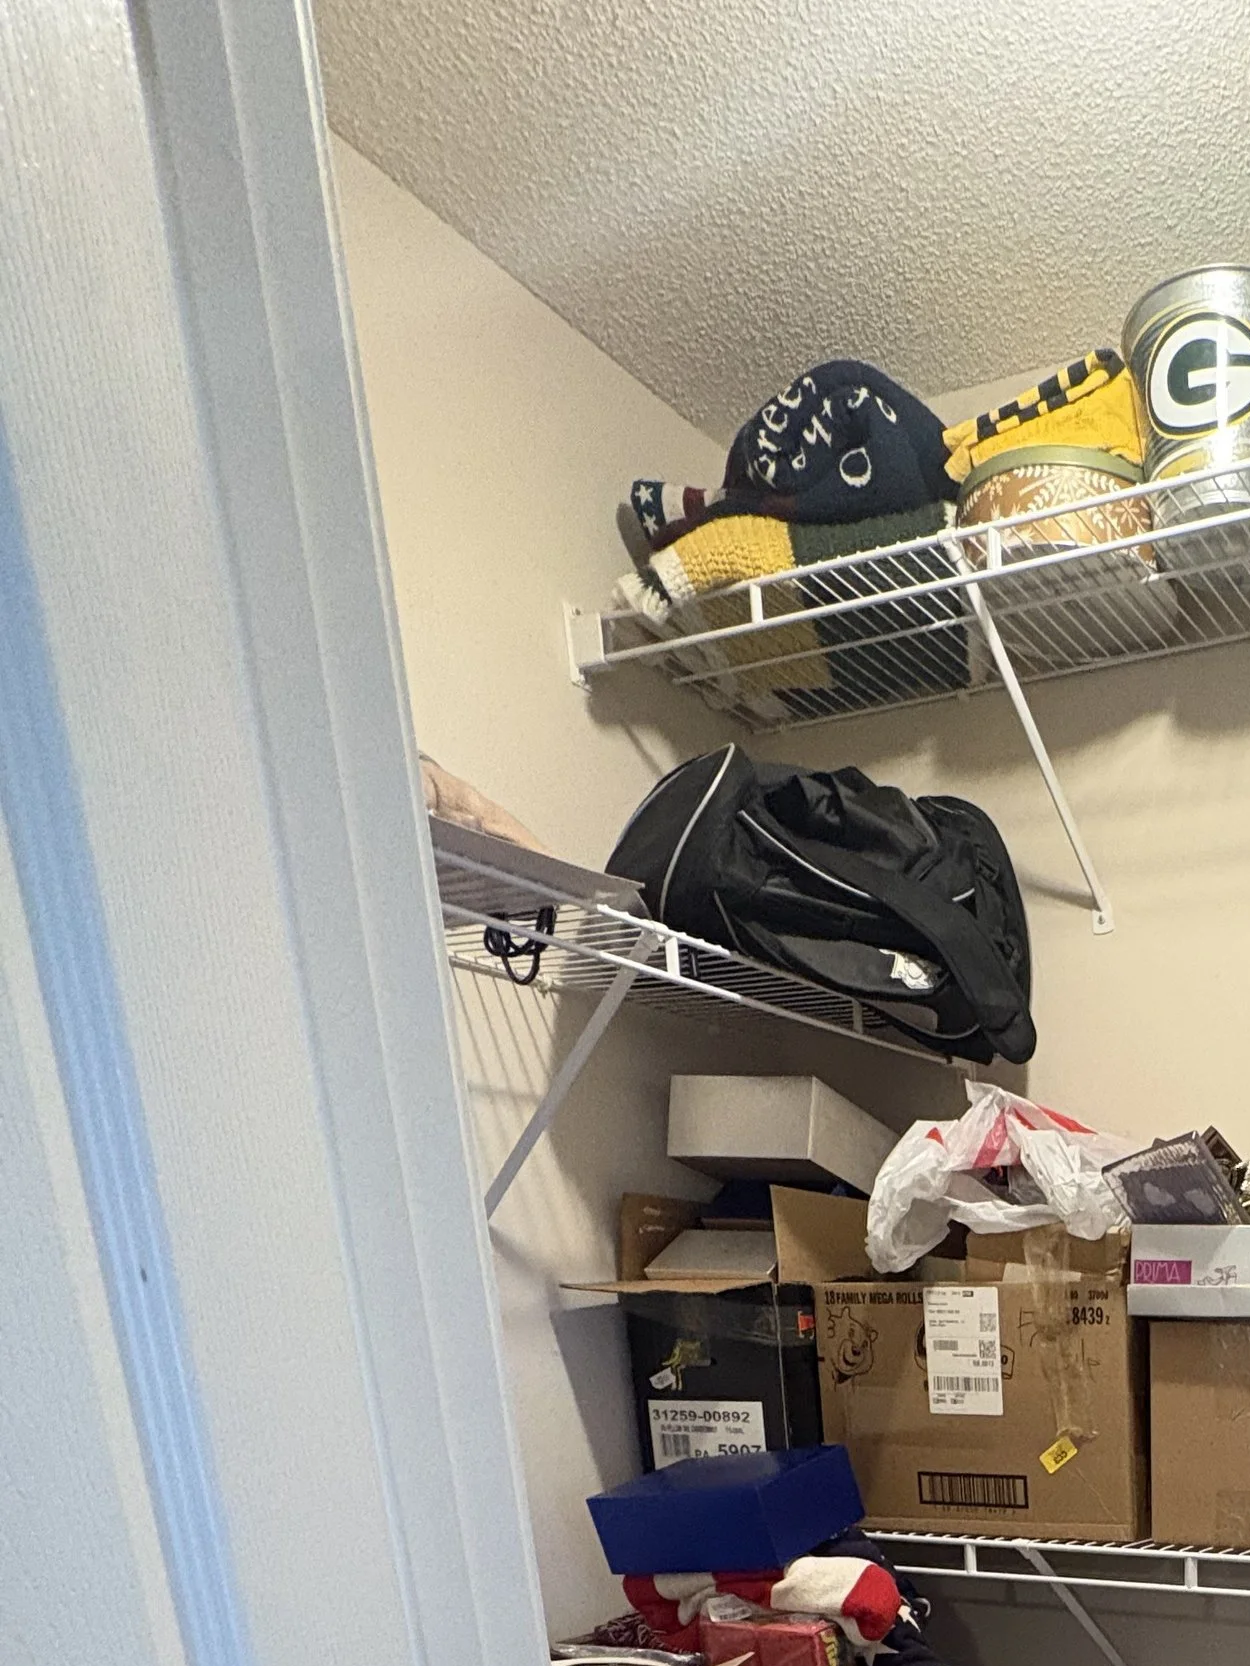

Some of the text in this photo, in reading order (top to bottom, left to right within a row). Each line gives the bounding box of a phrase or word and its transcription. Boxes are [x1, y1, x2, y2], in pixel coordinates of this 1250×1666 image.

[824, 1290, 923, 1305] 18 FAMILY MEGA ROLLS
[652, 1409, 751, 1423] 31259-00892
